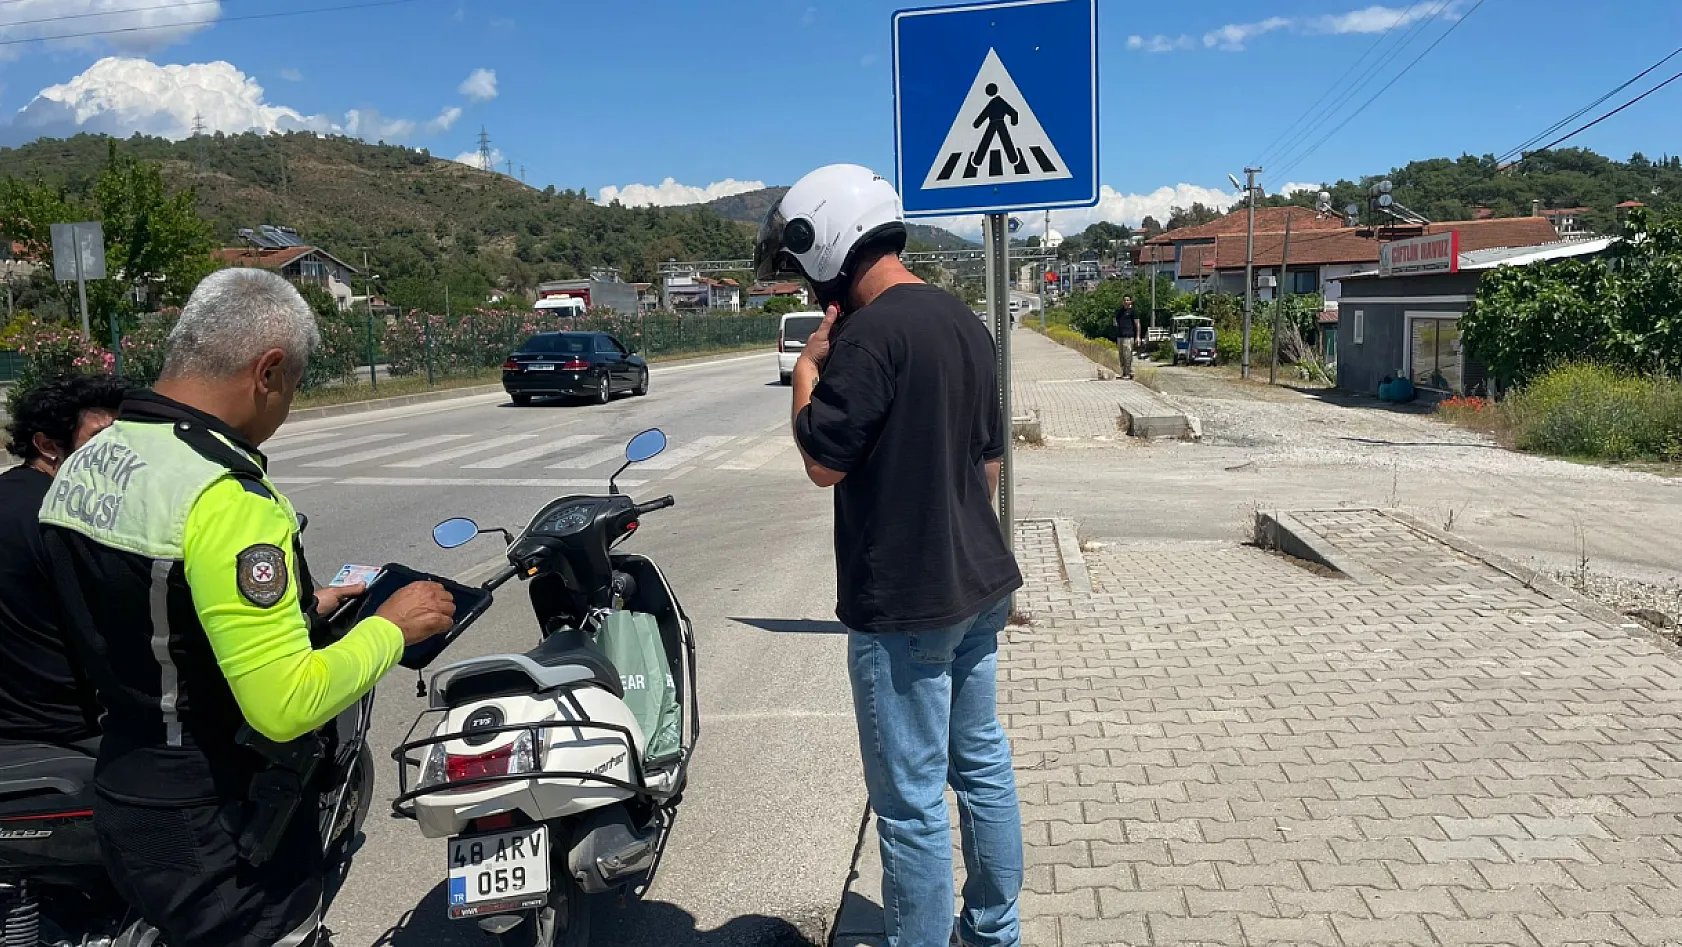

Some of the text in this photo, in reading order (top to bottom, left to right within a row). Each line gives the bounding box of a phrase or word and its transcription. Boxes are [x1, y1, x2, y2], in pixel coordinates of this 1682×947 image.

[454, 833, 541, 868] 48 ARV
[478, 866, 526, 896] 059
[454, 892, 465, 903] TR
